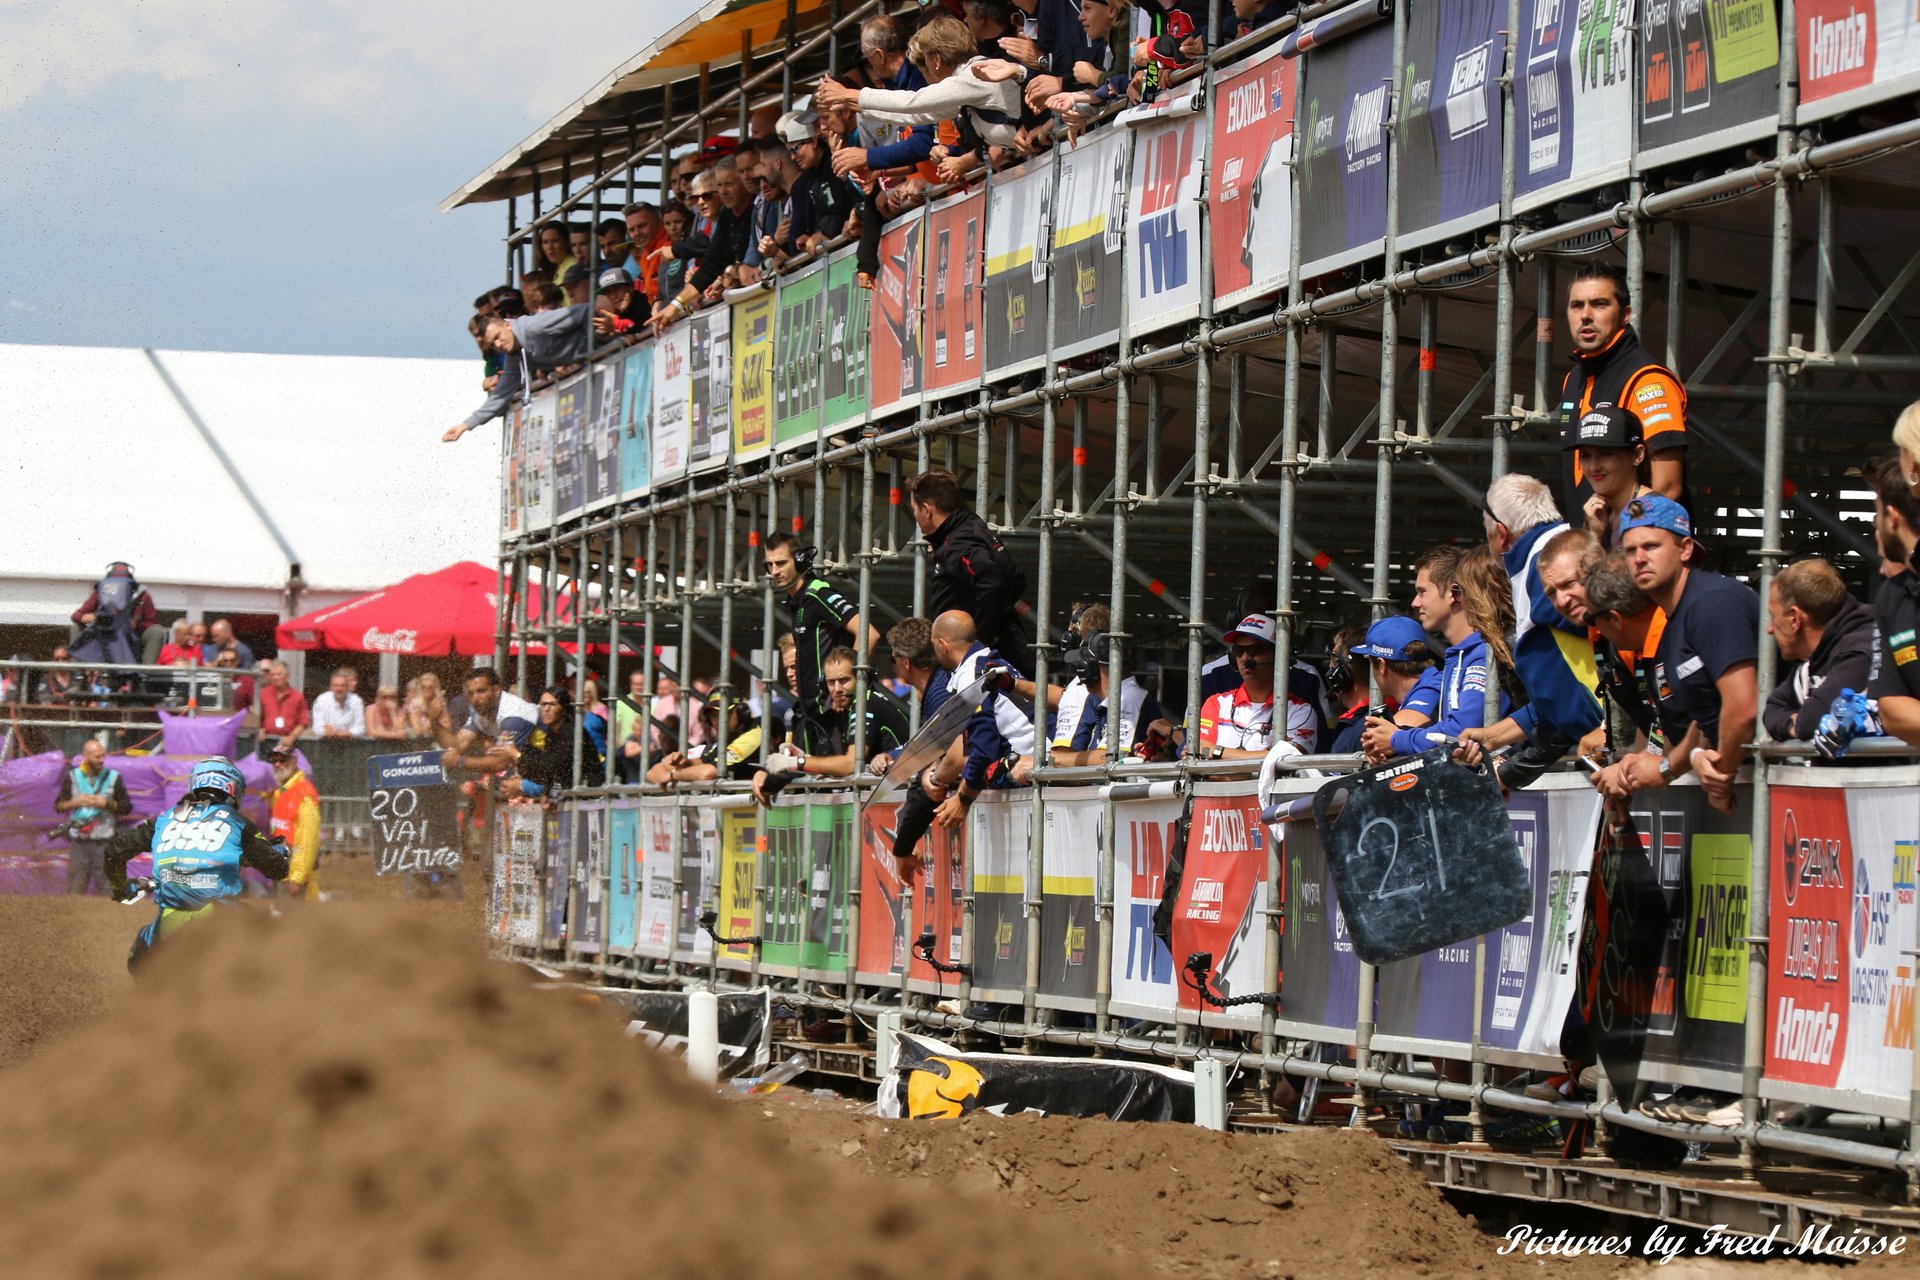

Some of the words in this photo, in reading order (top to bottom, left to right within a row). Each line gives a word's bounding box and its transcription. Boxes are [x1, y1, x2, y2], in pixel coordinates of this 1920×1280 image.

[1809, 6, 1867, 81] Honda
[1646, 52, 1670, 104] KTM
[1684, 41, 1706, 93] KTM
[1226, 77, 1267, 134] HONDA
[1354, 85, 1386, 154] YAMAHA
[1533, 117, 1557, 130] RACING
[1347, 158, 1365, 174] FACTORY
[1366, 152, 1382, 170] RACING
[1635, 384, 1662, 397] POWER
[1374, 759, 1425, 782] SATINK
[371, 788, 418, 820] 20
[156, 820, 232, 854] 999
[1199, 808, 1248, 853] HONDA
[1346, 807, 1447, 901] 21
[1186, 909, 1220, 920] RACING
[1870, 891, 1890, 946] HSF
[1438, 948, 1469, 963] RACING
[1783, 917, 1822, 982] LUCAS
[1822, 918, 1840, 983] OIL
[1501, 976, 1523, 989] RACING
[1852, 966, 1889, 1008] LOGISTICS
[1774, 996, 1839, 1066] Honda
